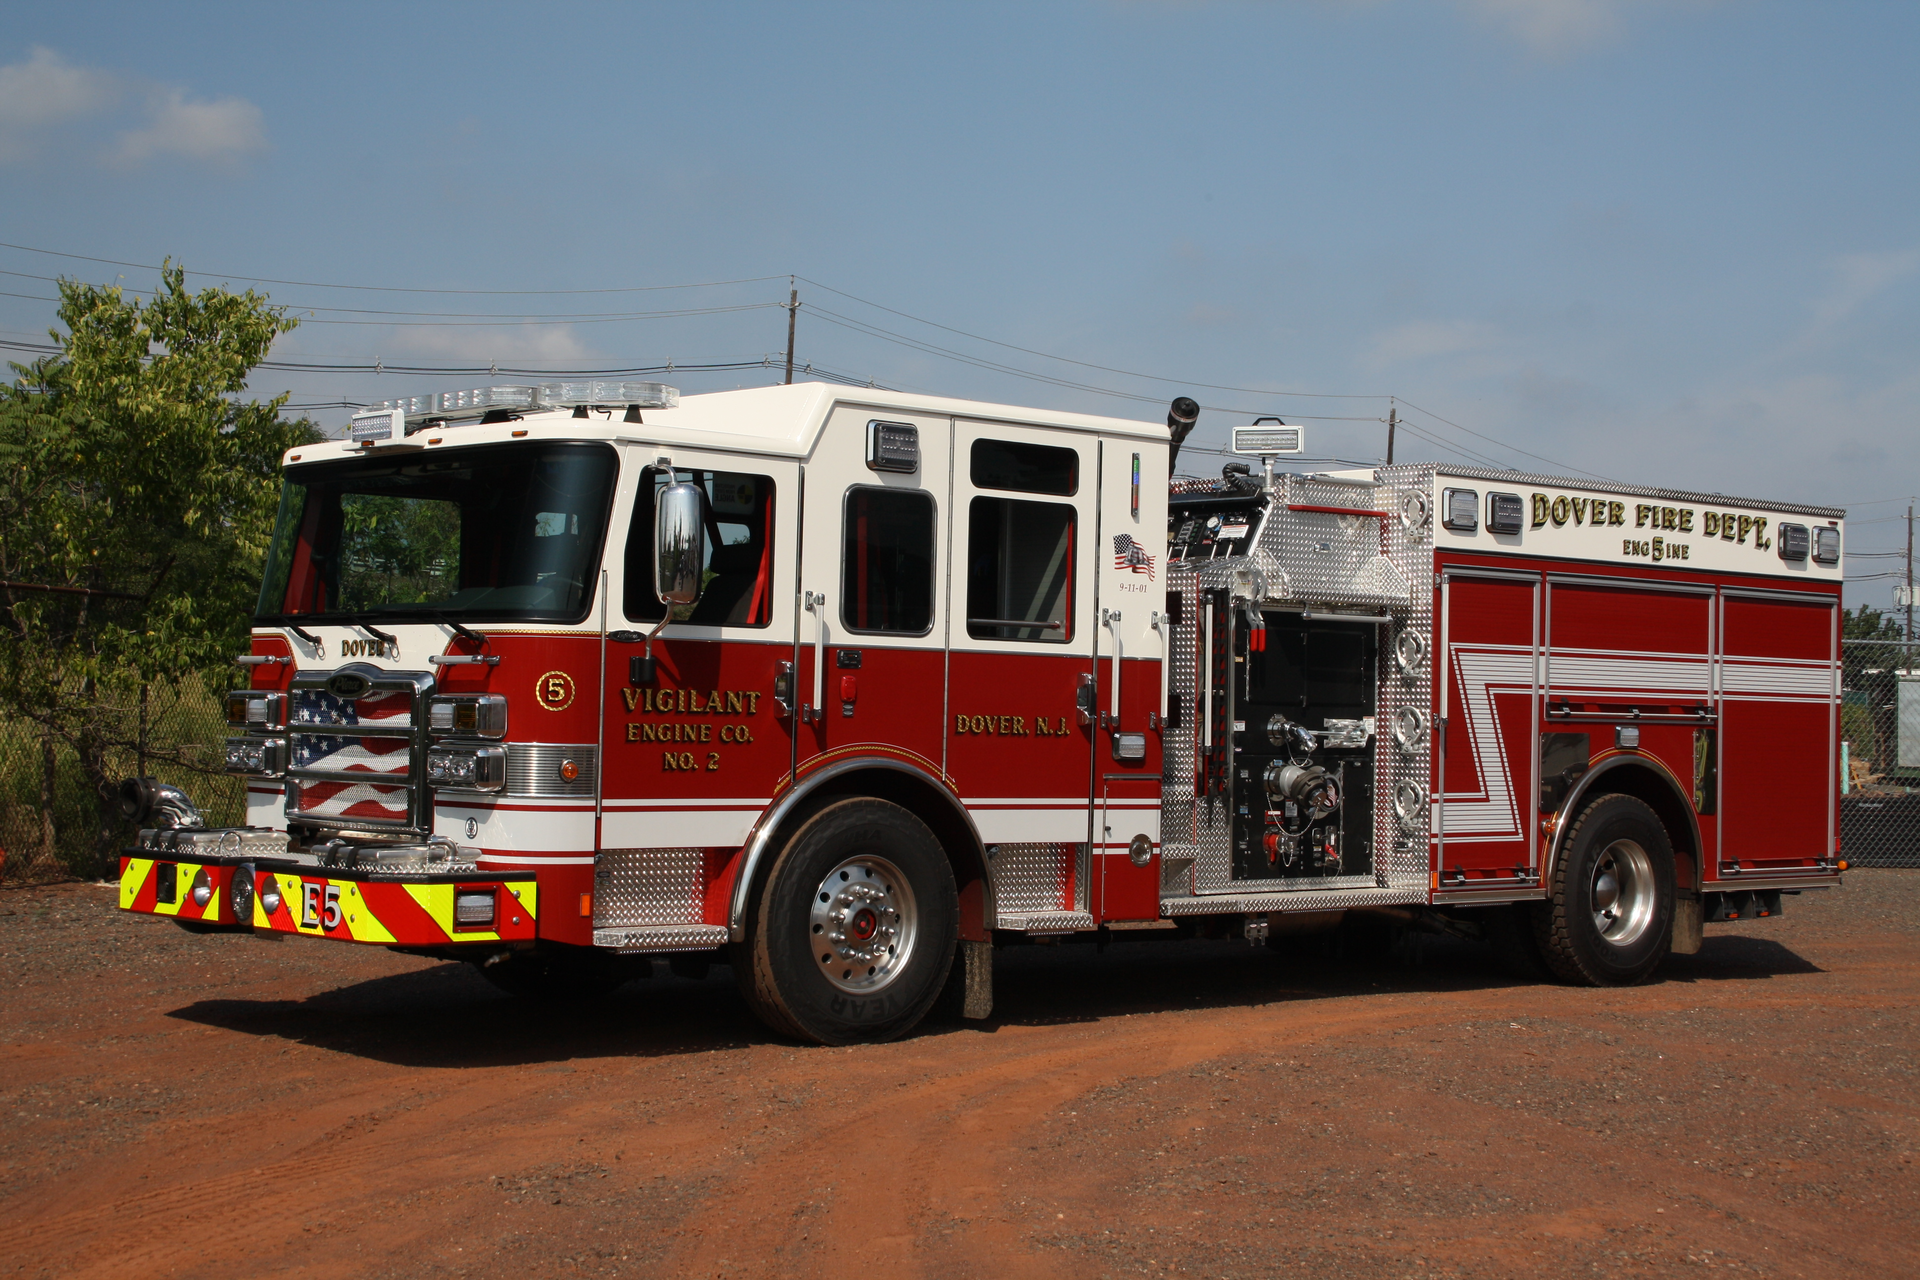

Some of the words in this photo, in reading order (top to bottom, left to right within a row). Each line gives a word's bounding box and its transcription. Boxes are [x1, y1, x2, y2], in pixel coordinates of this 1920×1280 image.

[1531, 492, 1626, 528] DOVER
[1635, 503, 1694, 532] FIRE
[1703, 511, 1772, 550] DEPT.
[1119, 583, 1147, 593] 9-11-01
[341, 639, 386, 657] DOVER
[332, 676, 361, 692] Pierce
[547, 678, 565, 702] 5
[621, 687, 761, 714] VIGILANT
[626, 722, 712, 743] ENGINE
[720, 724, 754, 744] CO.
[955, 714, 1030, 736] DOVER,
[663, 751, 699, 771] NO.
[707, 752, 720, 771] 2
[300, 883, 341, 931] E5
